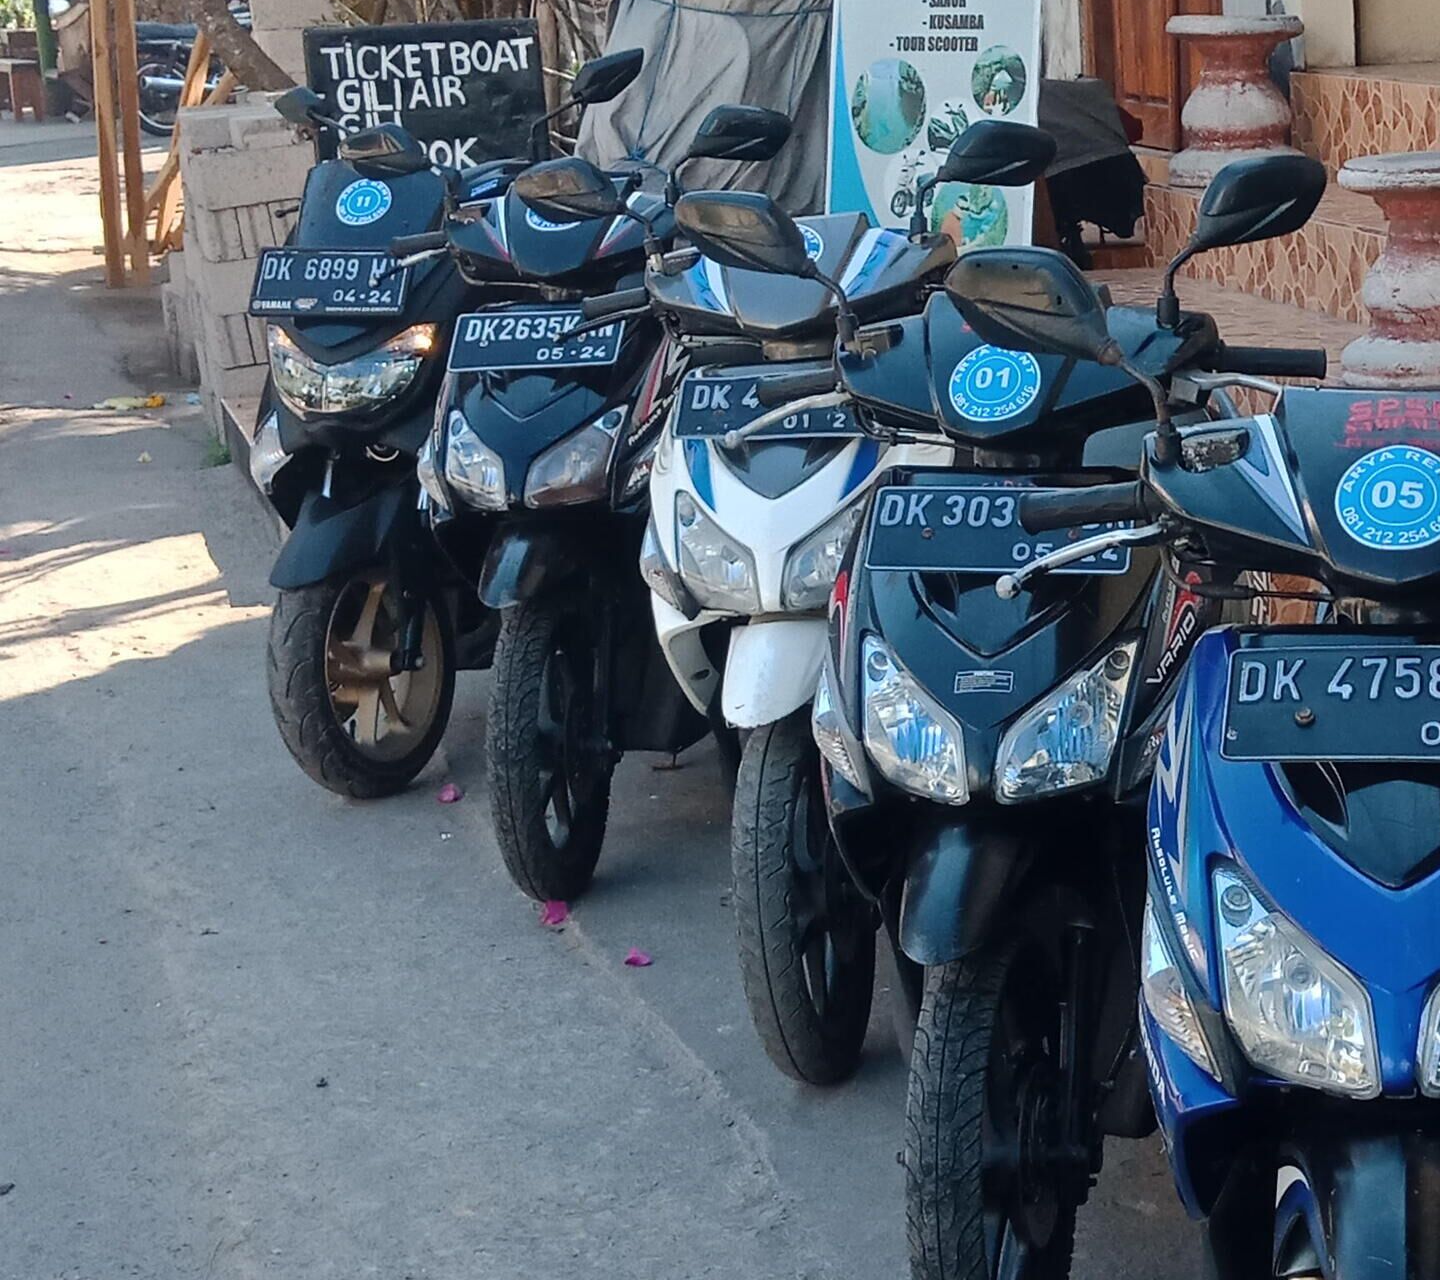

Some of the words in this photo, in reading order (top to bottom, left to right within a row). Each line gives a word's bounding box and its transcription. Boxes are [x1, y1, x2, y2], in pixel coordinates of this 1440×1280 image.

[929, 14, 984, 30] KUSAMBA
[449, 37, 534, 75] BOAT
[896, 36, 925, 52] TOUR
[927, 36, 978, 52] SCOOTER
[336, 79, 402, 113] GILI
[408, 75, 466, 110] AIR
[356, 195, 372, 208] 11
[264, 257, 294, 280] DK
[304, 258, 359, 280] 6899
[954, 348, 991, 383] ARYA
[974, 367, 1012, 389] 01
[691, 384, 731, 410] DK
[1342, 451, 1395, 493] ARYA
[879, 494, 934, 527] DK
[942, 496, 1023, 528] 303
[1371, 480, 1424, 509] 05
[1342, 507, 1364, 531] 081
[1363, 527, 1394, 543] 212
[1398, 527, 1430, 543] 254
[1145, 611, 1196, 684] VARIO
[1238, 660, 1304, 703] DK
